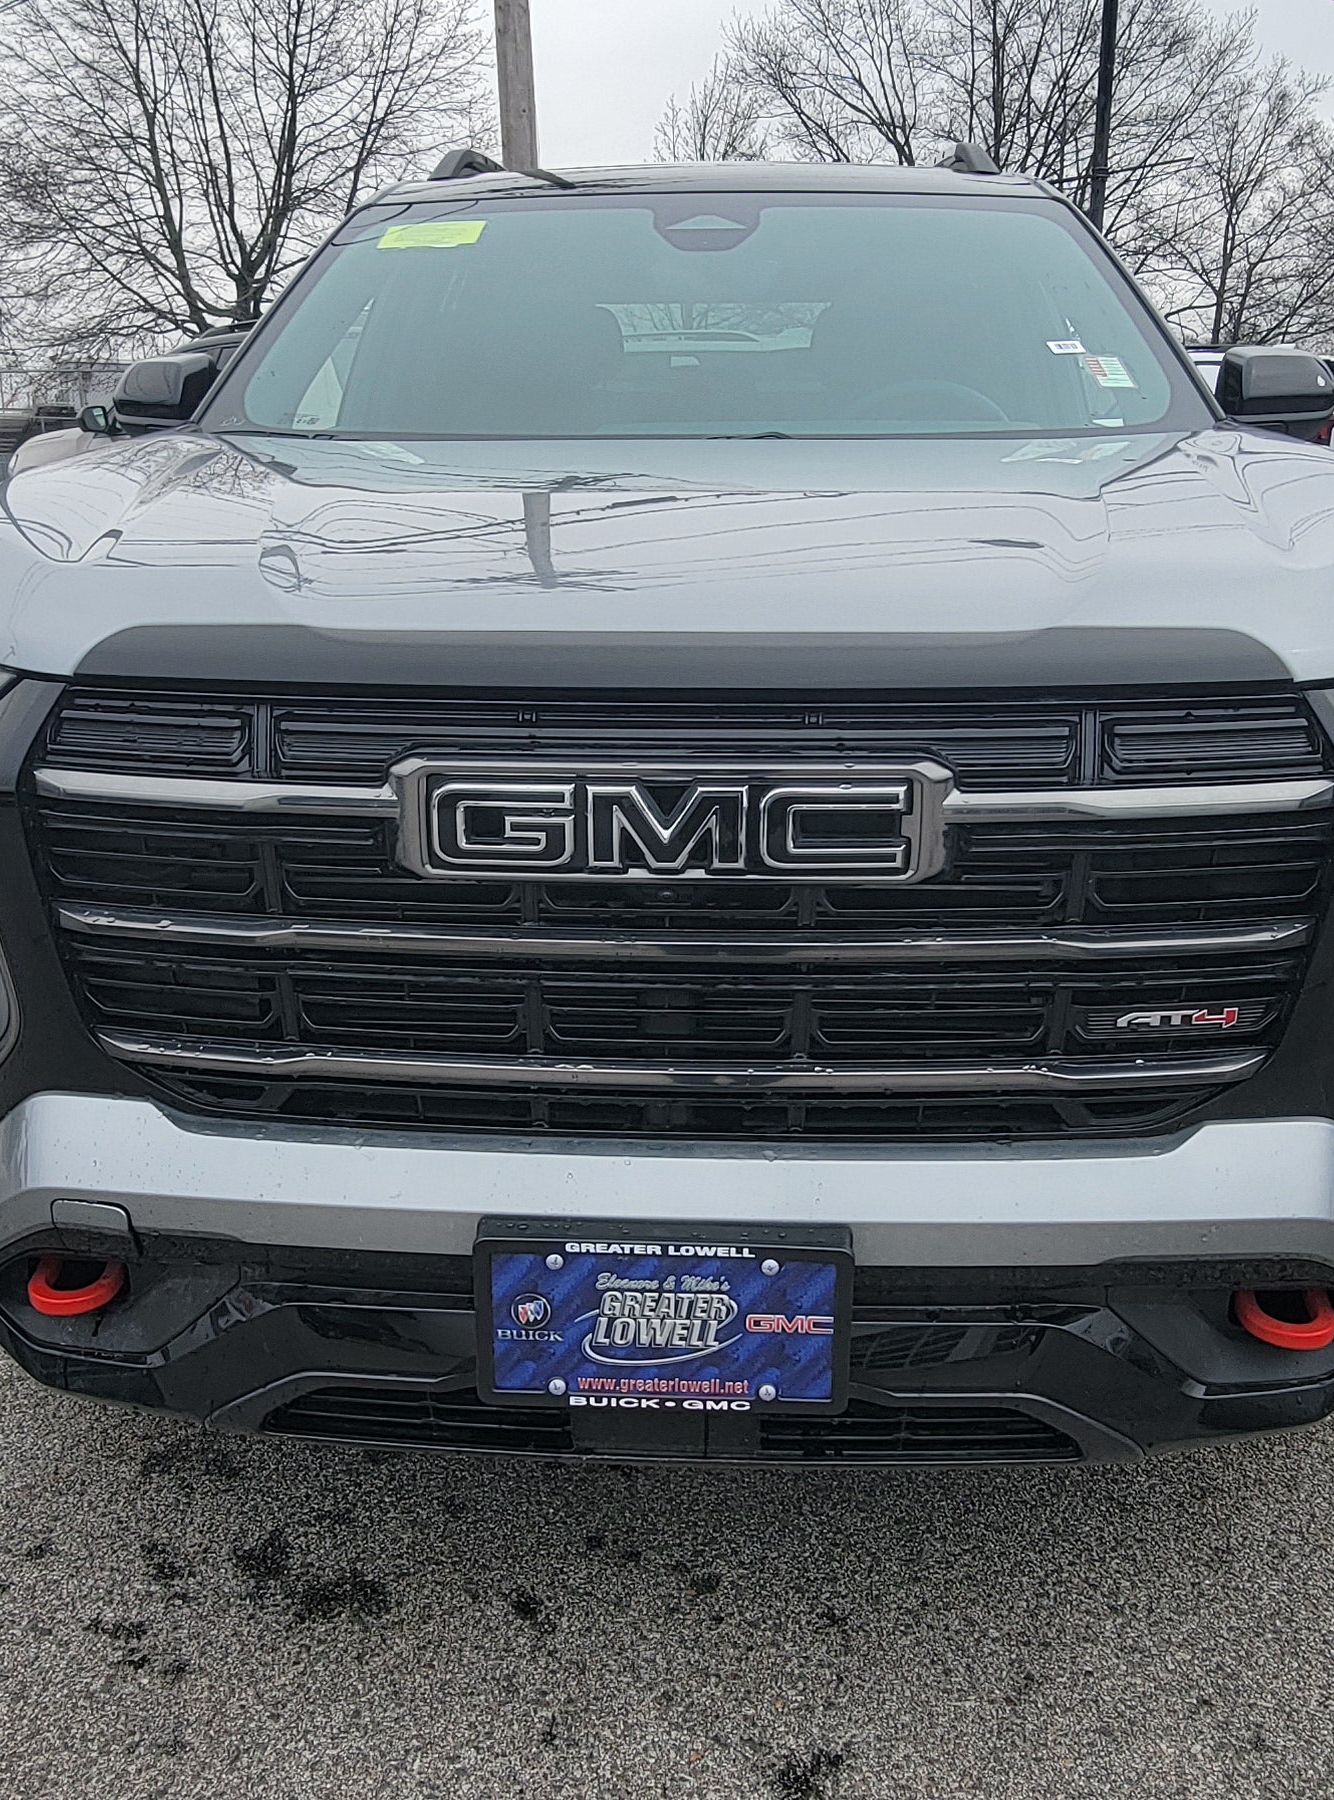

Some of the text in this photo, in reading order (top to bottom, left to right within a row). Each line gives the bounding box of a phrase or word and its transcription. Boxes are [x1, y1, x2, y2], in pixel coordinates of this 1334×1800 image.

[431, 782, 907, 870] GMC
[1116, 1007, 1239, 1029] AT4
[565, 1242, 756, 1259] GREATER LOWELL
[662, 1275, 677, 1290] &
[679, 1274, 731, 1292] Mike's
[599, 1290, 730, 1322] GREATER
[591, 1316, 720, 1349] LOWELL
[745, 1314, 835, 1334] GMC
[496, 1328, 564, 1343] BUICK
[577, 1377, 750, 1394] www.greaterlowell.net
[569, 1396, 752, 1411] BUICK GMC
